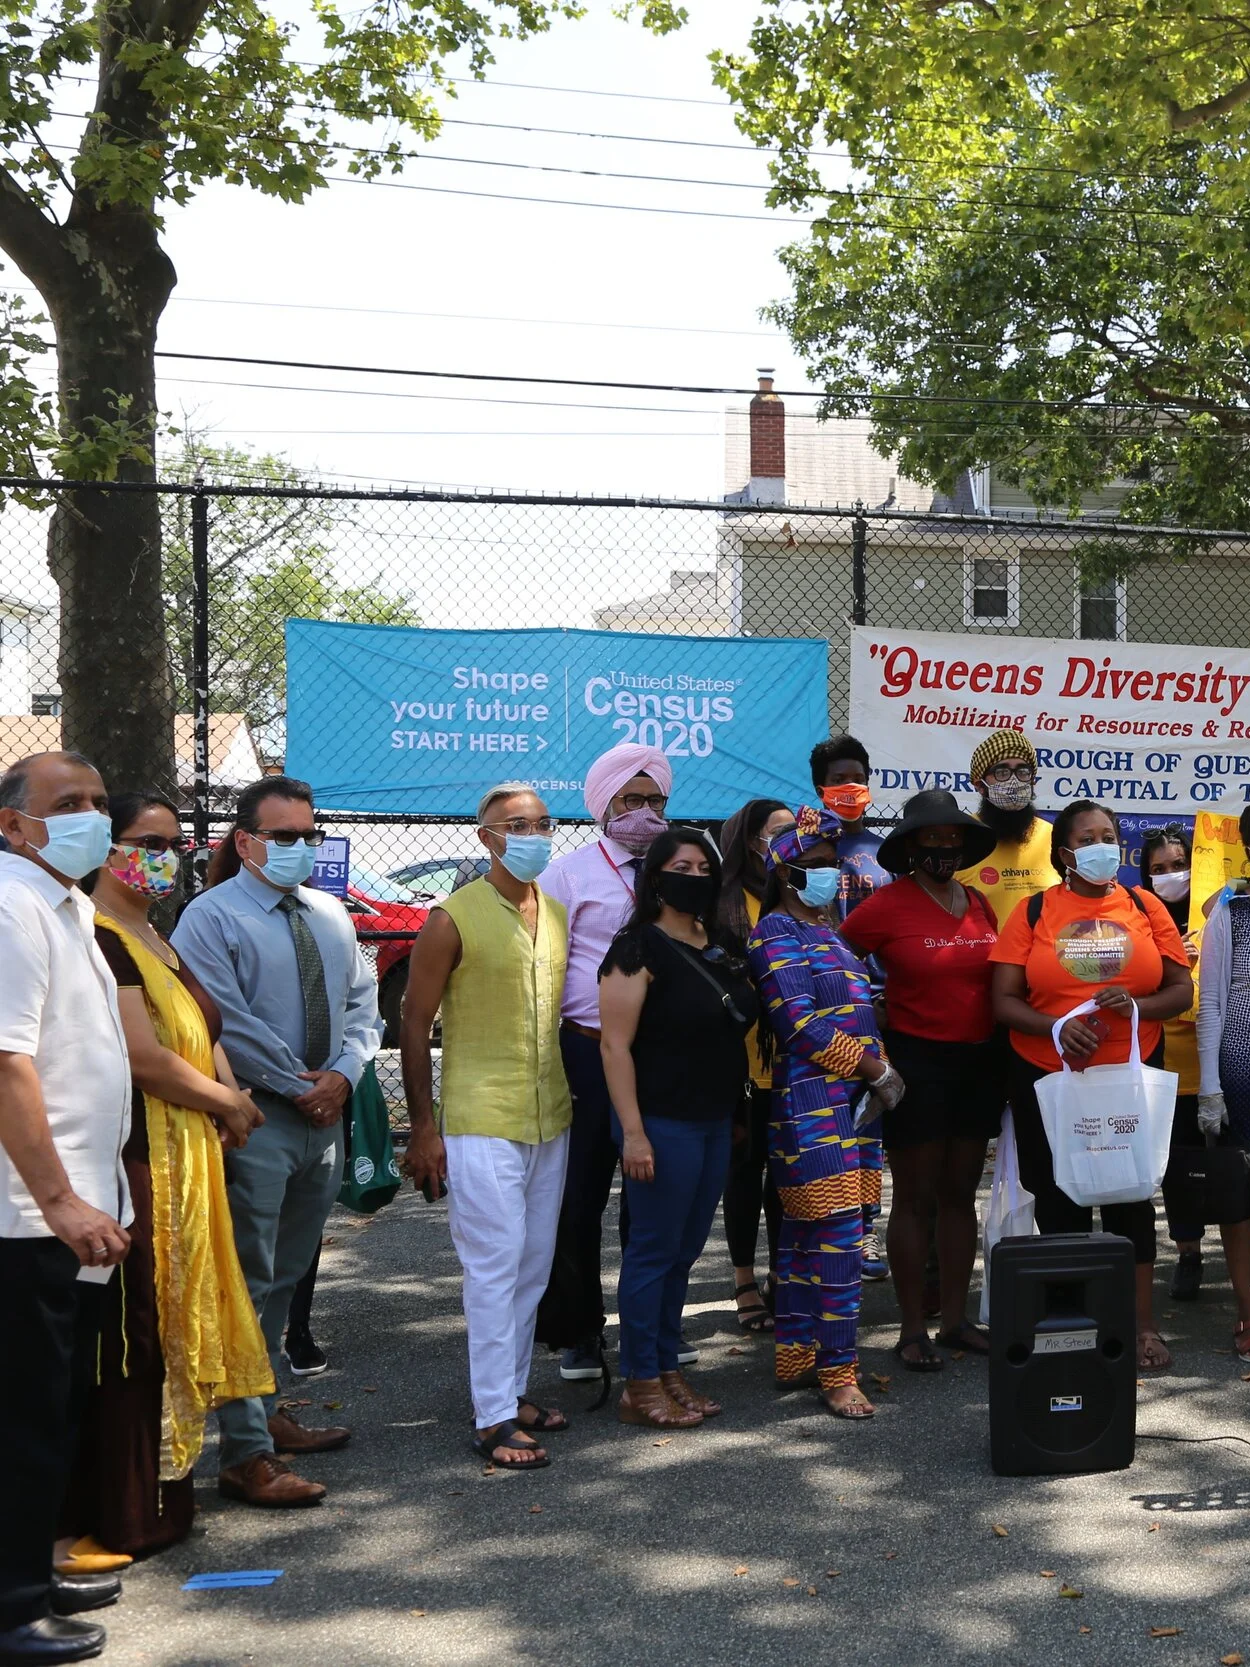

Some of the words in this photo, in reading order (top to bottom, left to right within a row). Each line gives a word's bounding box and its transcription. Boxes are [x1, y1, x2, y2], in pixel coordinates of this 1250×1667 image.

[453, 666, 550, 695] Shape
[610, 670, 674, 691] United
[869, 643, 1044, 698] "Queens
[390, 700, 456, 724] your
[465, 697, 549, 722] future
[584, 676, 734, 722] Census
[903, 704, 1027, 733] Mobilizing
[1035, 711, 1068, 732] for
[1077, 714, 1193, 737] Resources
[1202, 720, 1219, 738] &
[390, 731, 463, 752] START
[469, 732, 529, 752] HERE
[612, 718, 714, 758] 2020
[1036, 749, 1133, 771] ROUGH
[1145, 753, 1182, 773] OF
[1054, 776, 1178, 800] CAPITAL
[1190, 781, 1227, 801] OF
[1119, 818, 1136, 831] City
[1139, 820, 1167, 831] Council
[1001, 868, 1030, 877] chhaya
[924, 937, 955, 948] Delta
[955, 935, 987, 948] Sigma
[1108, 1117, 1139, 1126] Census
[1114, 1125, 1136, 1134] 2020
